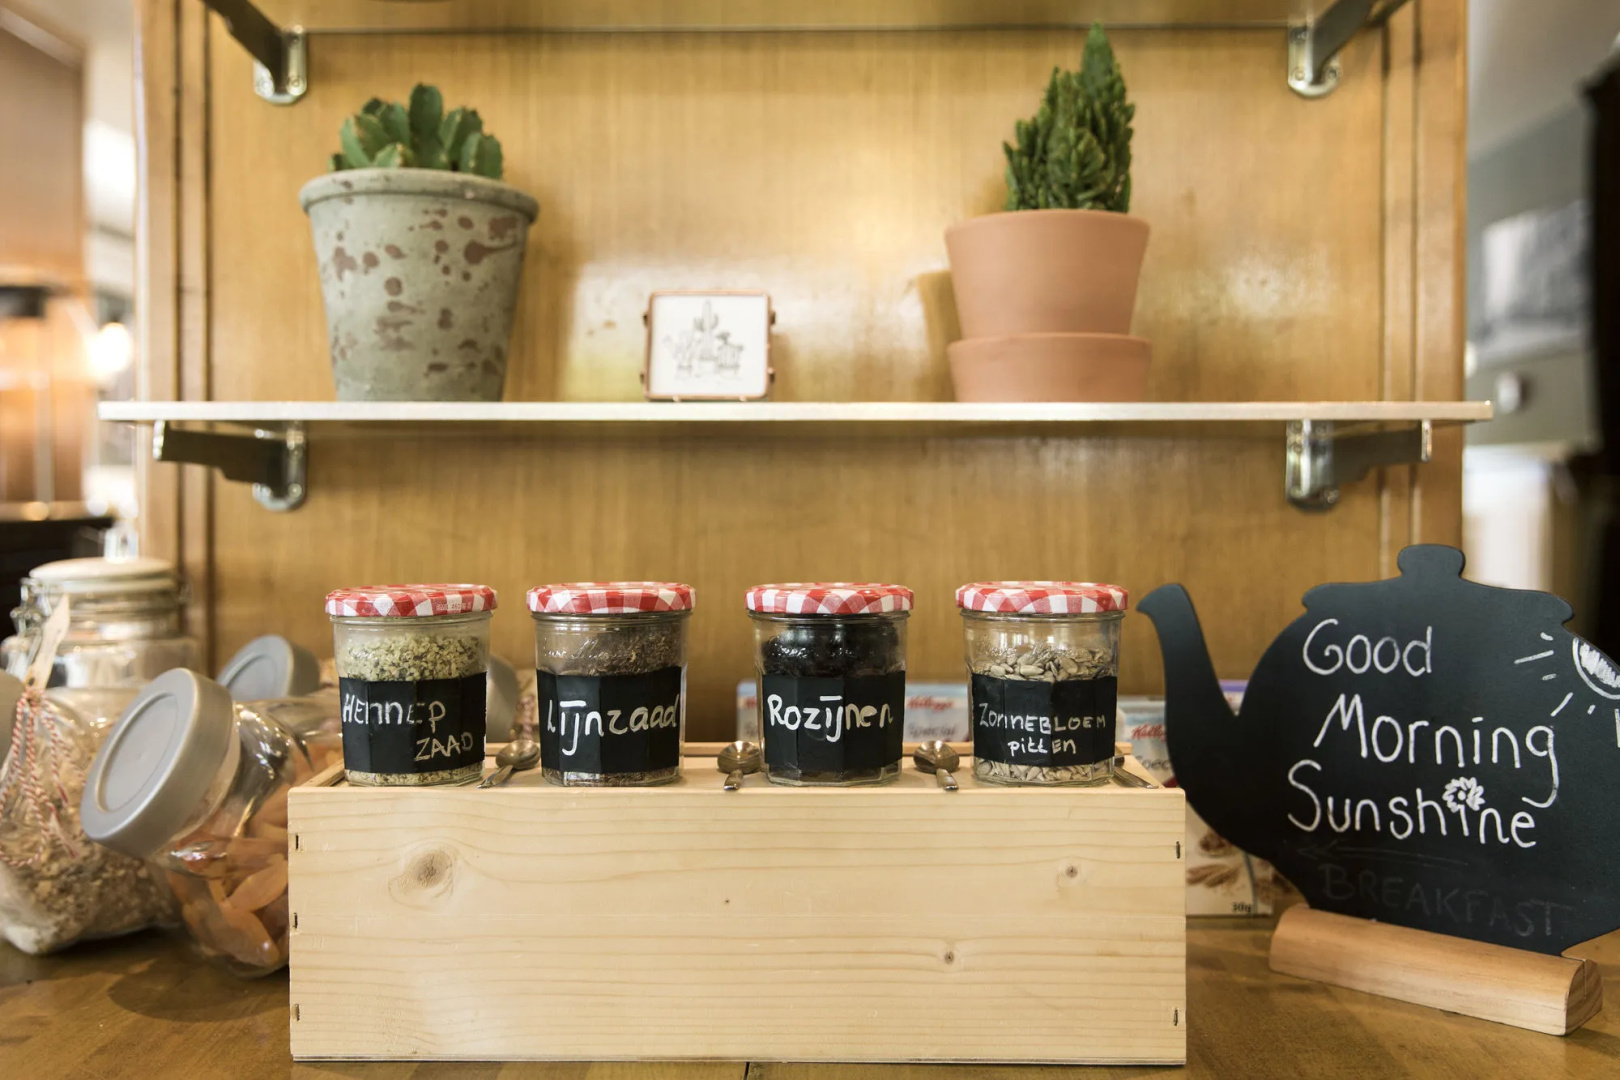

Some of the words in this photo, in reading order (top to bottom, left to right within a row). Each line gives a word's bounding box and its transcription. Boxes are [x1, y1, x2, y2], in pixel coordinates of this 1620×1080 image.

[1302, 618, 1433, 678] Good
[413, 731, 474, 762] ZAAD
[766, 693, 894, 743] Rozijnen
[1312, 693, 1560, 809] Morning
[1287, 758, 1537, 849] Sunshine
[1316, 863, 1575, 937] BREAKFAST
